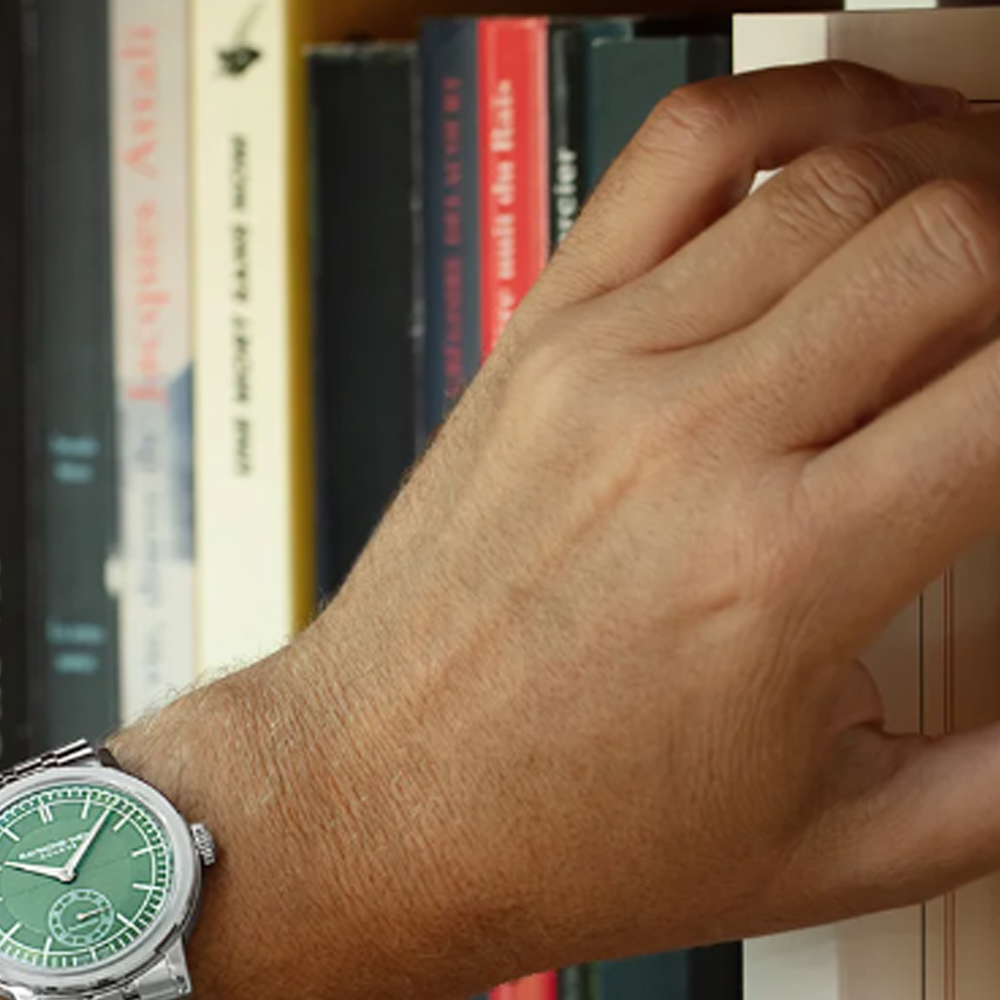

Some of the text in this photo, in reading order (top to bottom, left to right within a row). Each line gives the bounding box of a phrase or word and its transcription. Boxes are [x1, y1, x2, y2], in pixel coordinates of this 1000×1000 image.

[118, 24, 159, 180] Attali
[490, 160, 514, 206] du
[491, 213, 514, 279] nuit
[125, 200, 172, 410] Jacques
